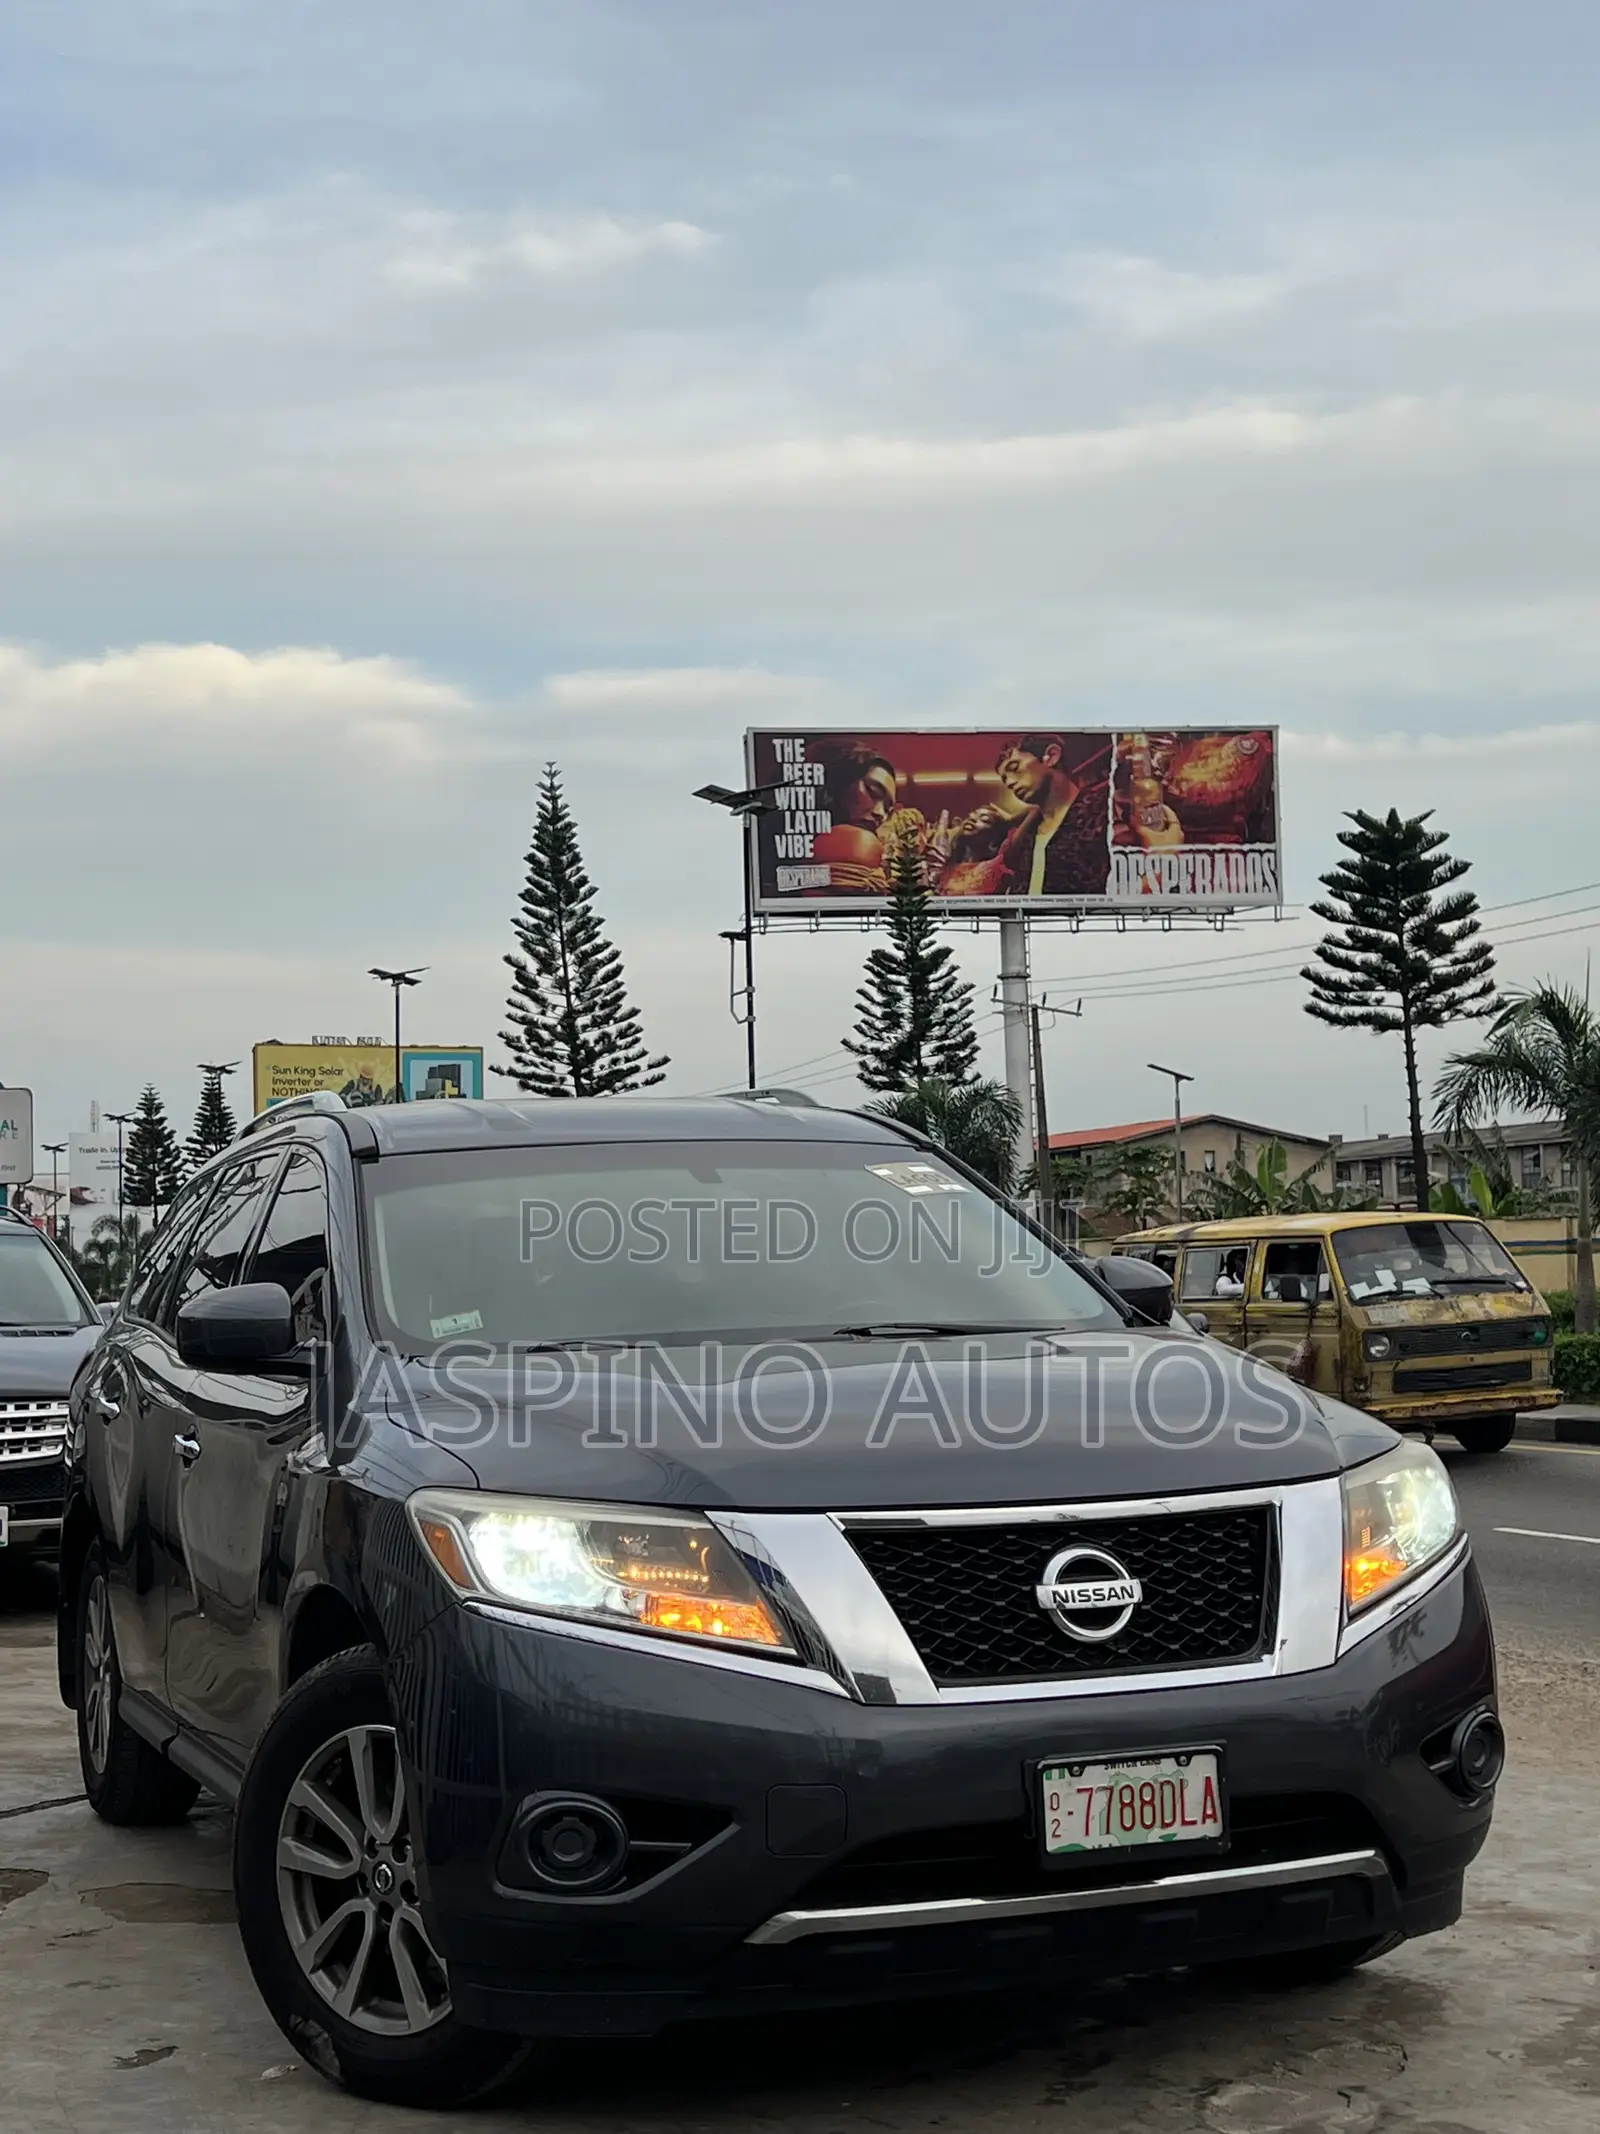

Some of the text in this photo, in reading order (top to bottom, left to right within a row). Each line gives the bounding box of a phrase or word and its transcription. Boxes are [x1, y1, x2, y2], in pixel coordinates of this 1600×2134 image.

[772, 738, 805, 763] THE
[783, 763, 825, 785] BEER
[774, 787, 816, 810] WITH
[785, 811, 832, 834] LATIN
[775, 835, 815, 859] VIBE
[1112, 851, 1277, 895] DESPERADOS
[272, 1065, 345, 1077] Sun King Solar
[272, 1076, 311, 1086] Inverter
[1051, 1584, 1135, 1604] NISSAN
